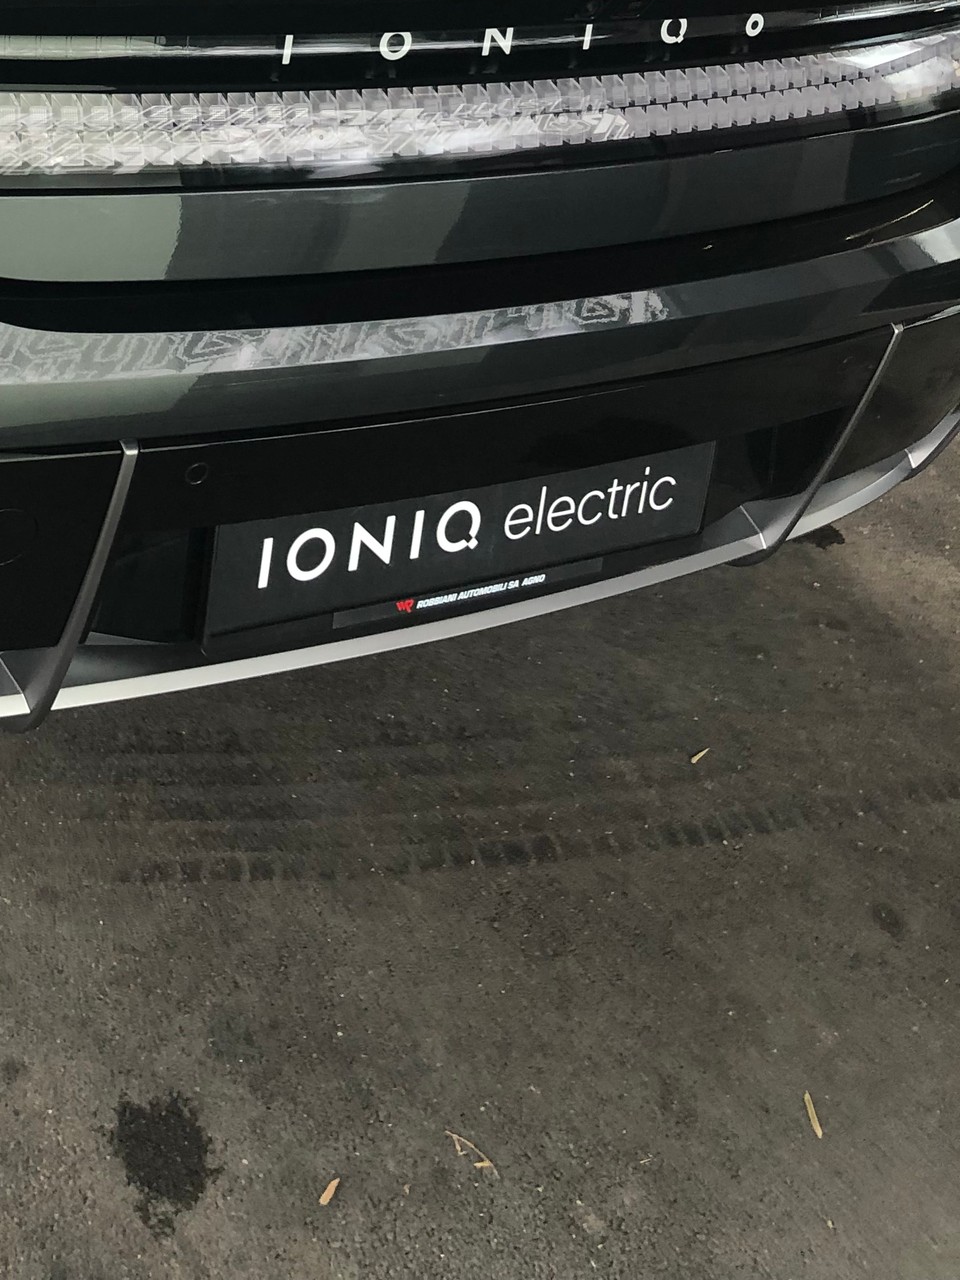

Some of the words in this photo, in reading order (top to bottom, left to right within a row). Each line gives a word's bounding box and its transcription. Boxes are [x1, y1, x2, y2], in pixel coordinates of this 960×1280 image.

[258, 501, 481, 588] IONIQ
[503, 465, 677, 541] electric
[417, 593, 458, 609] ROBBIANI
[458, 582, 507, 600] AUTOMOBILI
[507, 578, 520, 590] SA
[521, 573, 547, 587] AGNO
